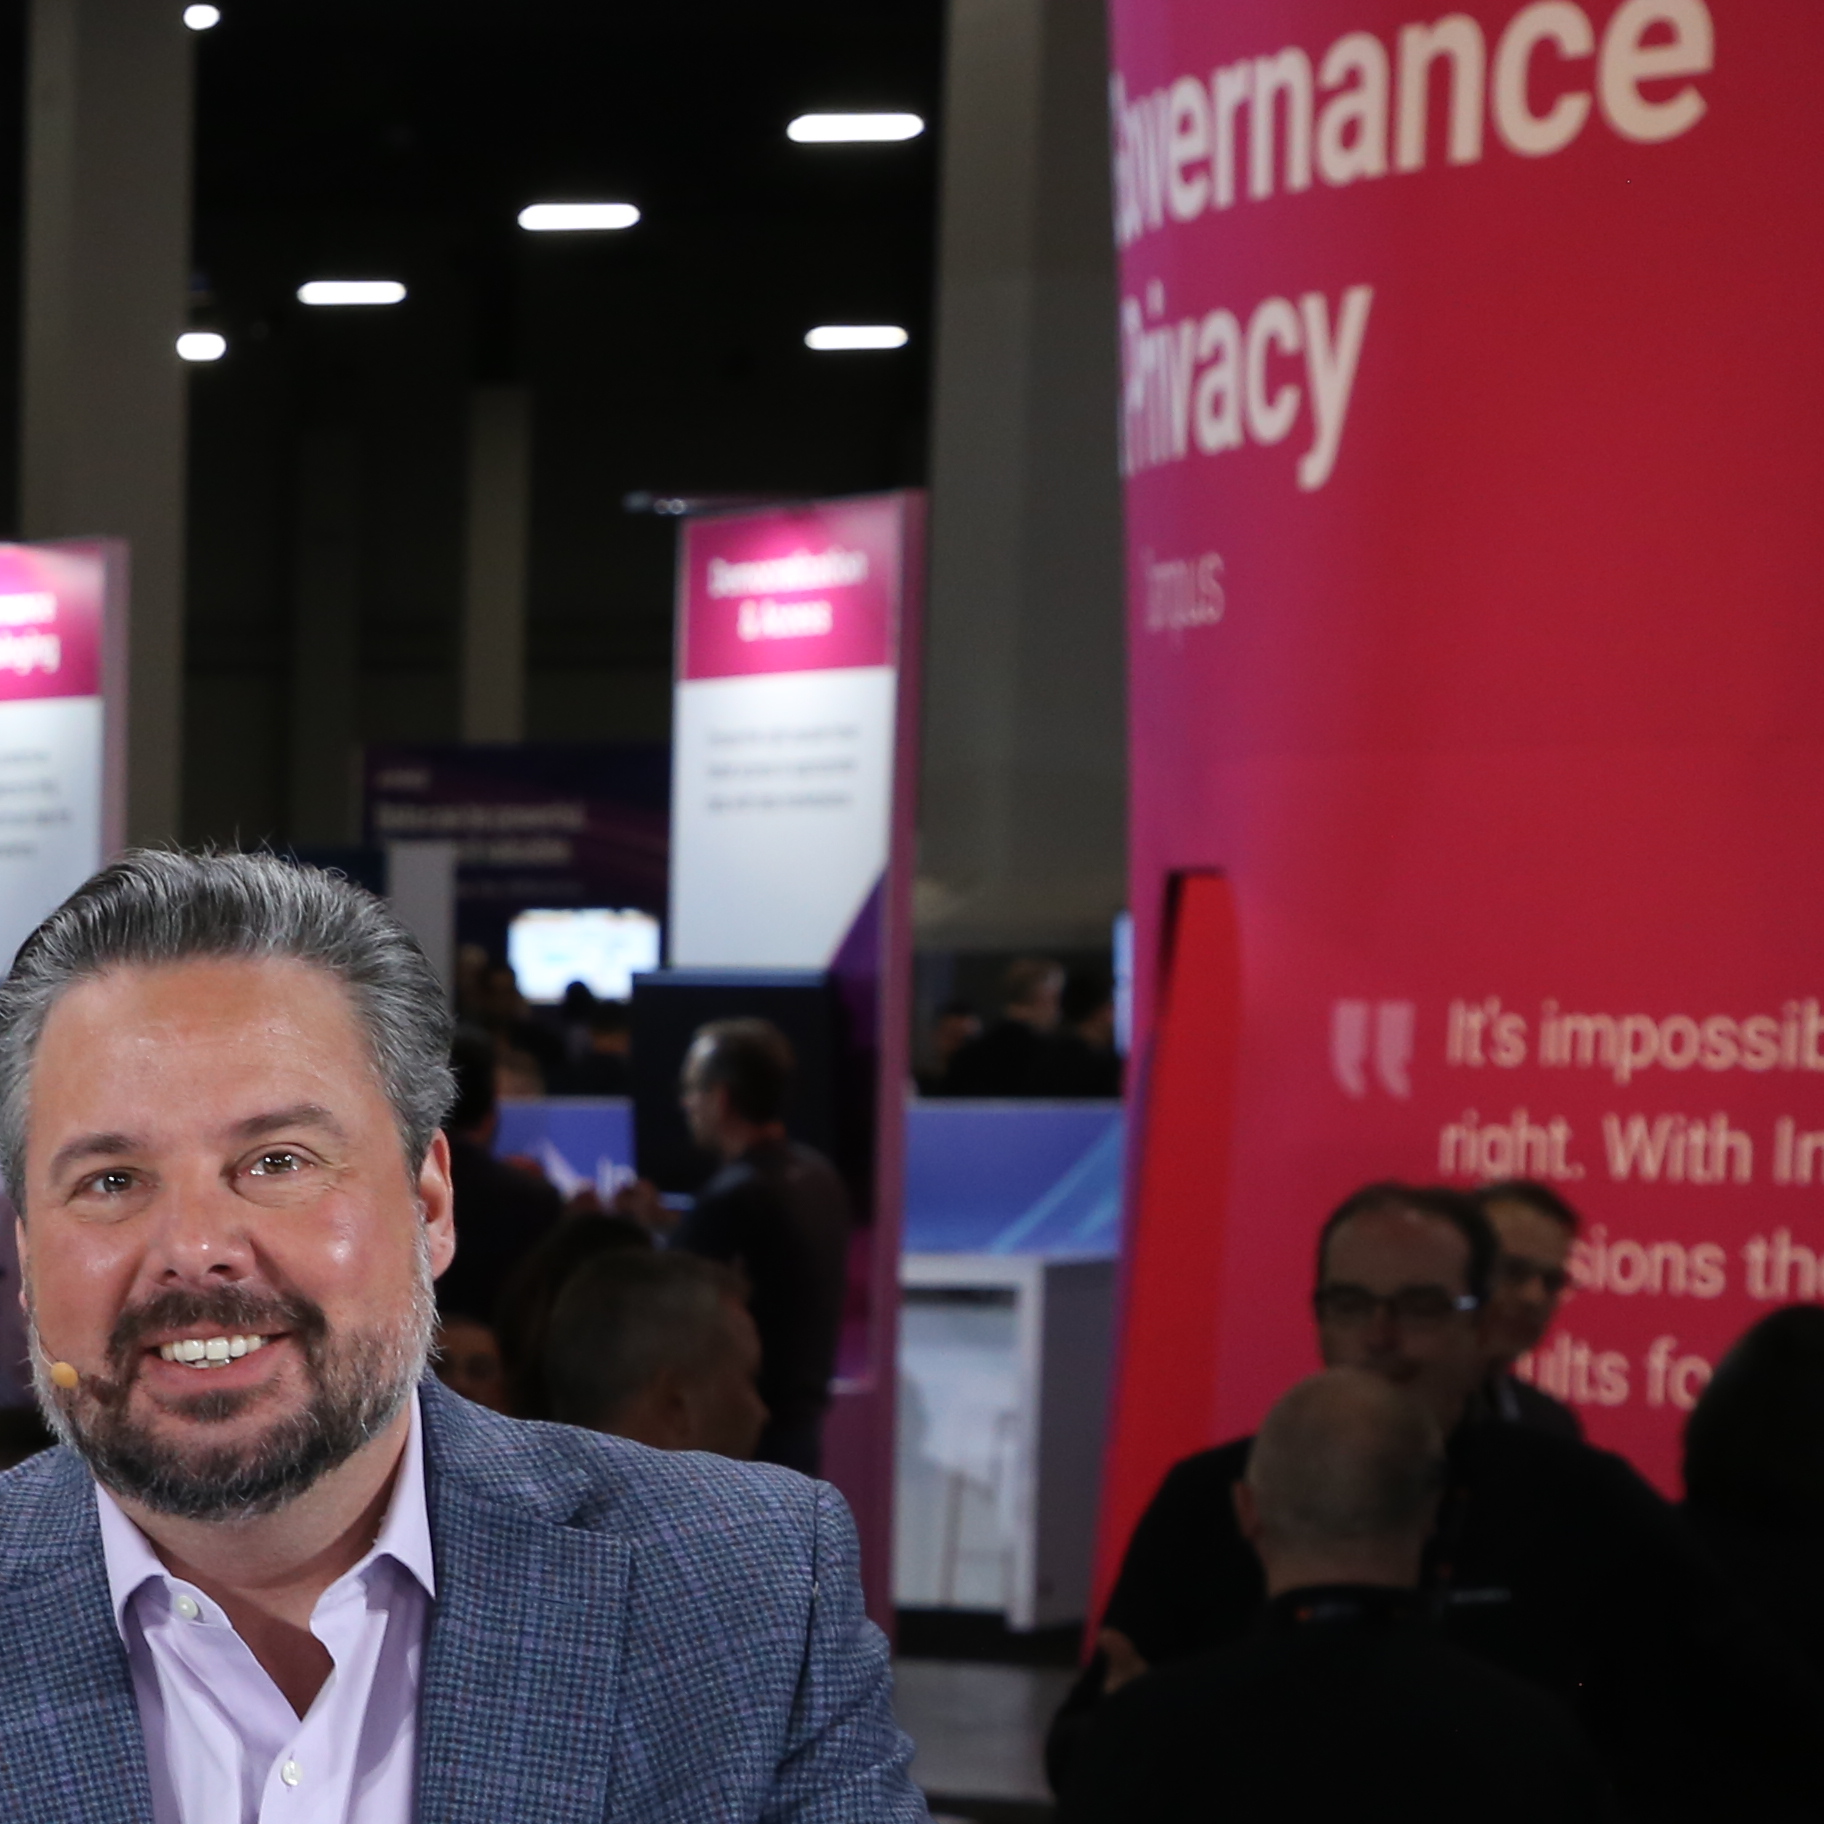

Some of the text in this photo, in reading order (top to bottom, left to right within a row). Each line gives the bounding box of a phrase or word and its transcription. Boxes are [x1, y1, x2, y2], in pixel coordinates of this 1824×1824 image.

[1446, 995, 1528, 1069] It's
[1602, 1110, 1752, 1184] With
[1566, 1223, 1824, 1300] sions th
[1515, 1332, 1713, 1411] ults fo
